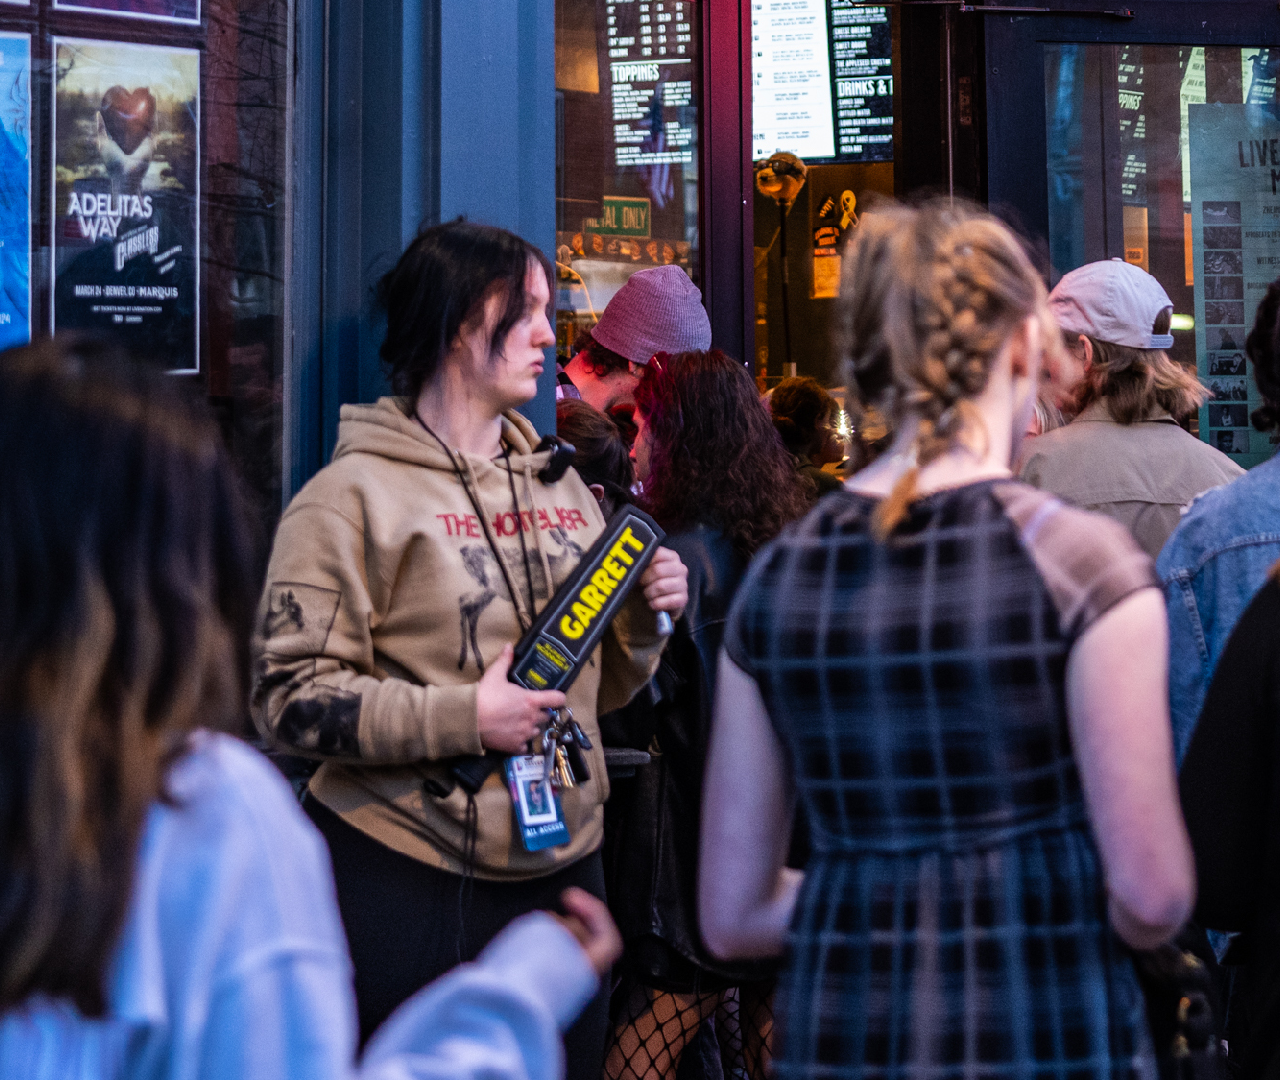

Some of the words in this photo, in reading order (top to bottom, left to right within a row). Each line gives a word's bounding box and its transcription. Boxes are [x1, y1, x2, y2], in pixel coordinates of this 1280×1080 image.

[611, 64, 660, 83] TOPPINGS
[837, 80, 875, 98] DRINKS
[876, 79, 888, 96] &
[1238, 139, 1280, 168] LIVE
[68, 192, 153, 219] ADELITAS
[622, 206, 647, 229] ONLY
[80, 216, 122, 243] WAY
[75, 285, 94, 297] MARCH
[139, 286, 179, 301] MARQUIS
[436, 513, 482, 539] THE
[559, 525, 645, 640] GARRETT
[526, 827, 538, 838] ALL
[539, 821, 566, 834] ACCESS
